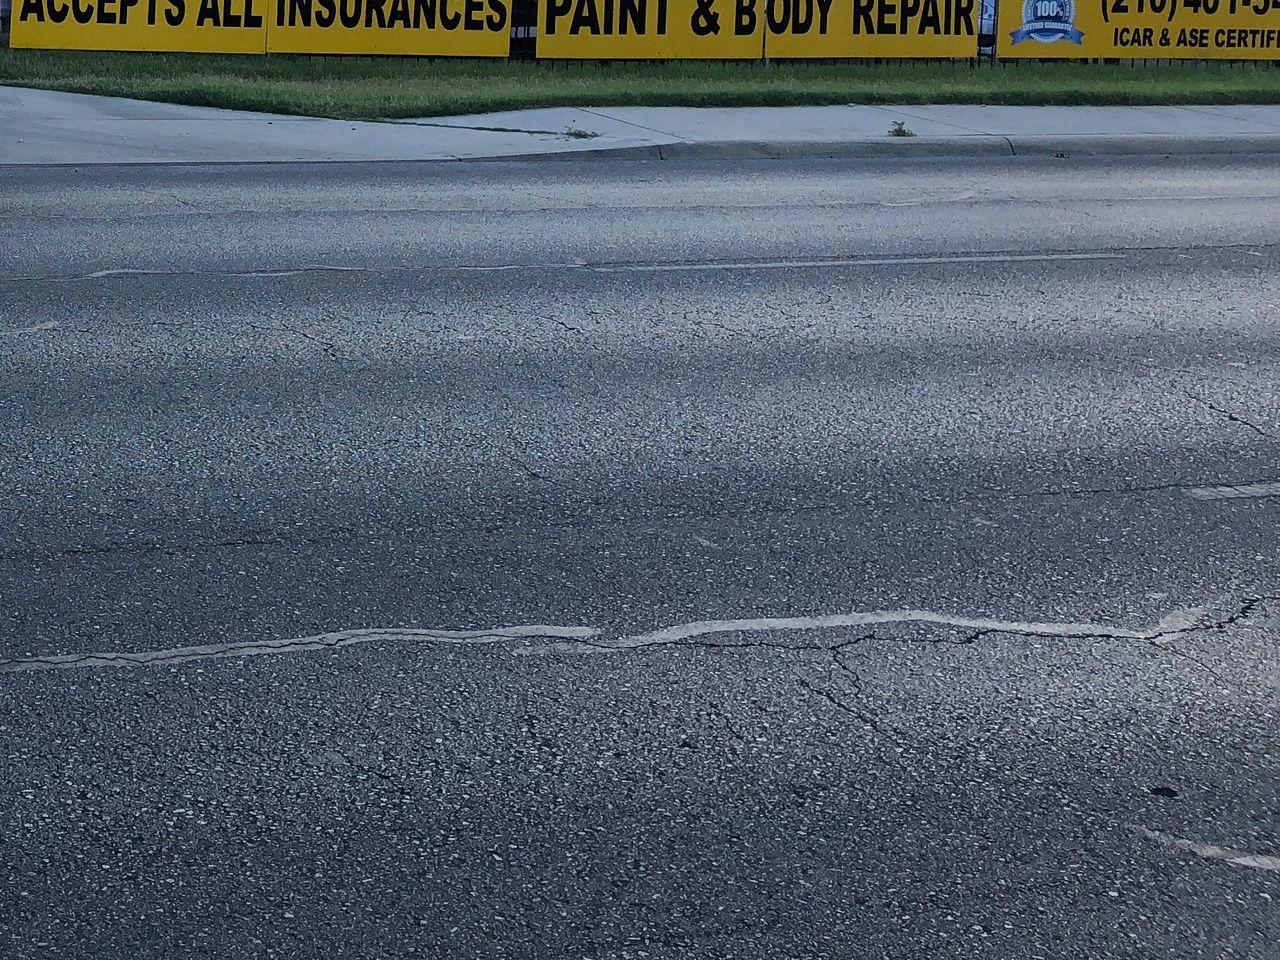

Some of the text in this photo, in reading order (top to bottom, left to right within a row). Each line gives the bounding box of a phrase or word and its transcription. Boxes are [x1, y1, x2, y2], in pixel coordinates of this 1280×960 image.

[1036, 0, 1064, 17] 100%
[1113, 27, 1153, 47] ICAR
[1158, 27, 1171, 47] &
[1176, 28, 1210, 48] ASE
